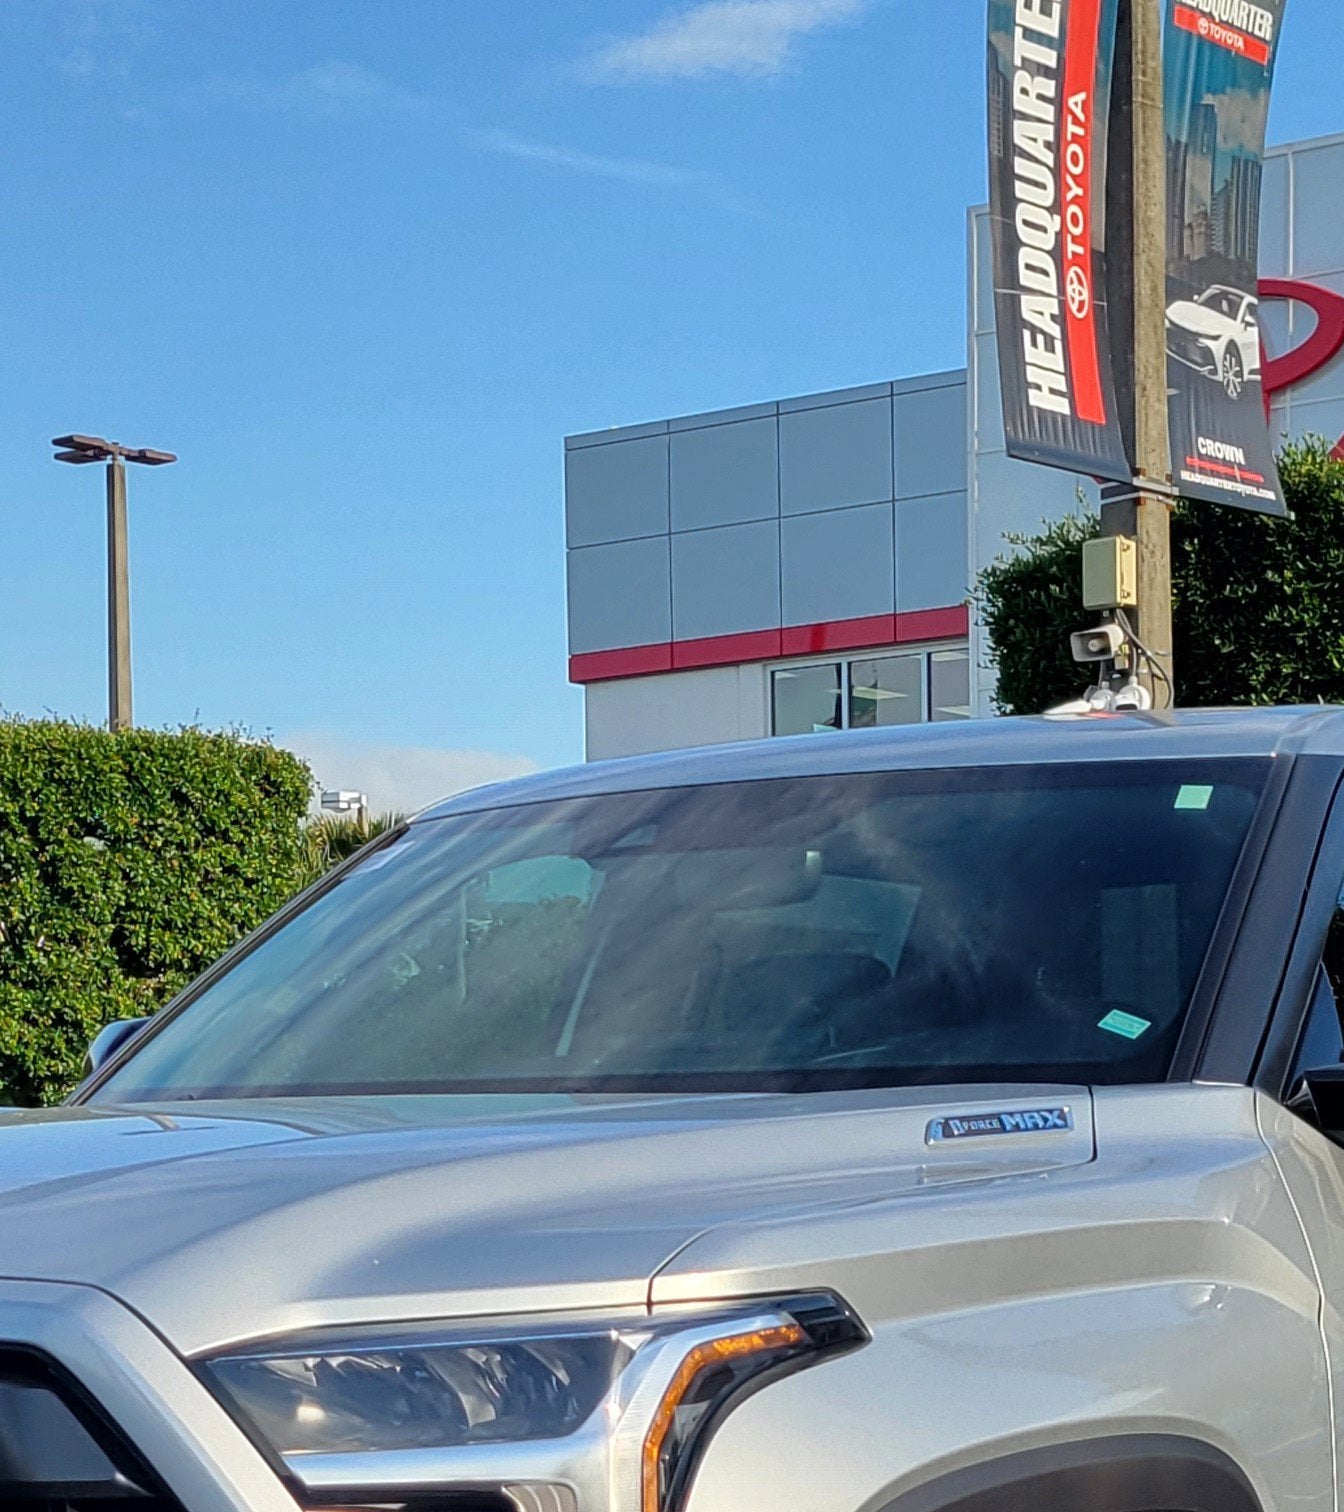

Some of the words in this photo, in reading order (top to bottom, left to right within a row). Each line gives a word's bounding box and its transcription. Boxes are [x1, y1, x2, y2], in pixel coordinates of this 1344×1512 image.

[1209, 23, 1245, 51] TOYOTA
[1065, 91, 1087, 260] TOYOTA
[1013, 0, 1071, 416] HEADQUARTE
[1197, 436, 1246, 466] CROWN
[1000, 1110, 1066, 1131] MAX
